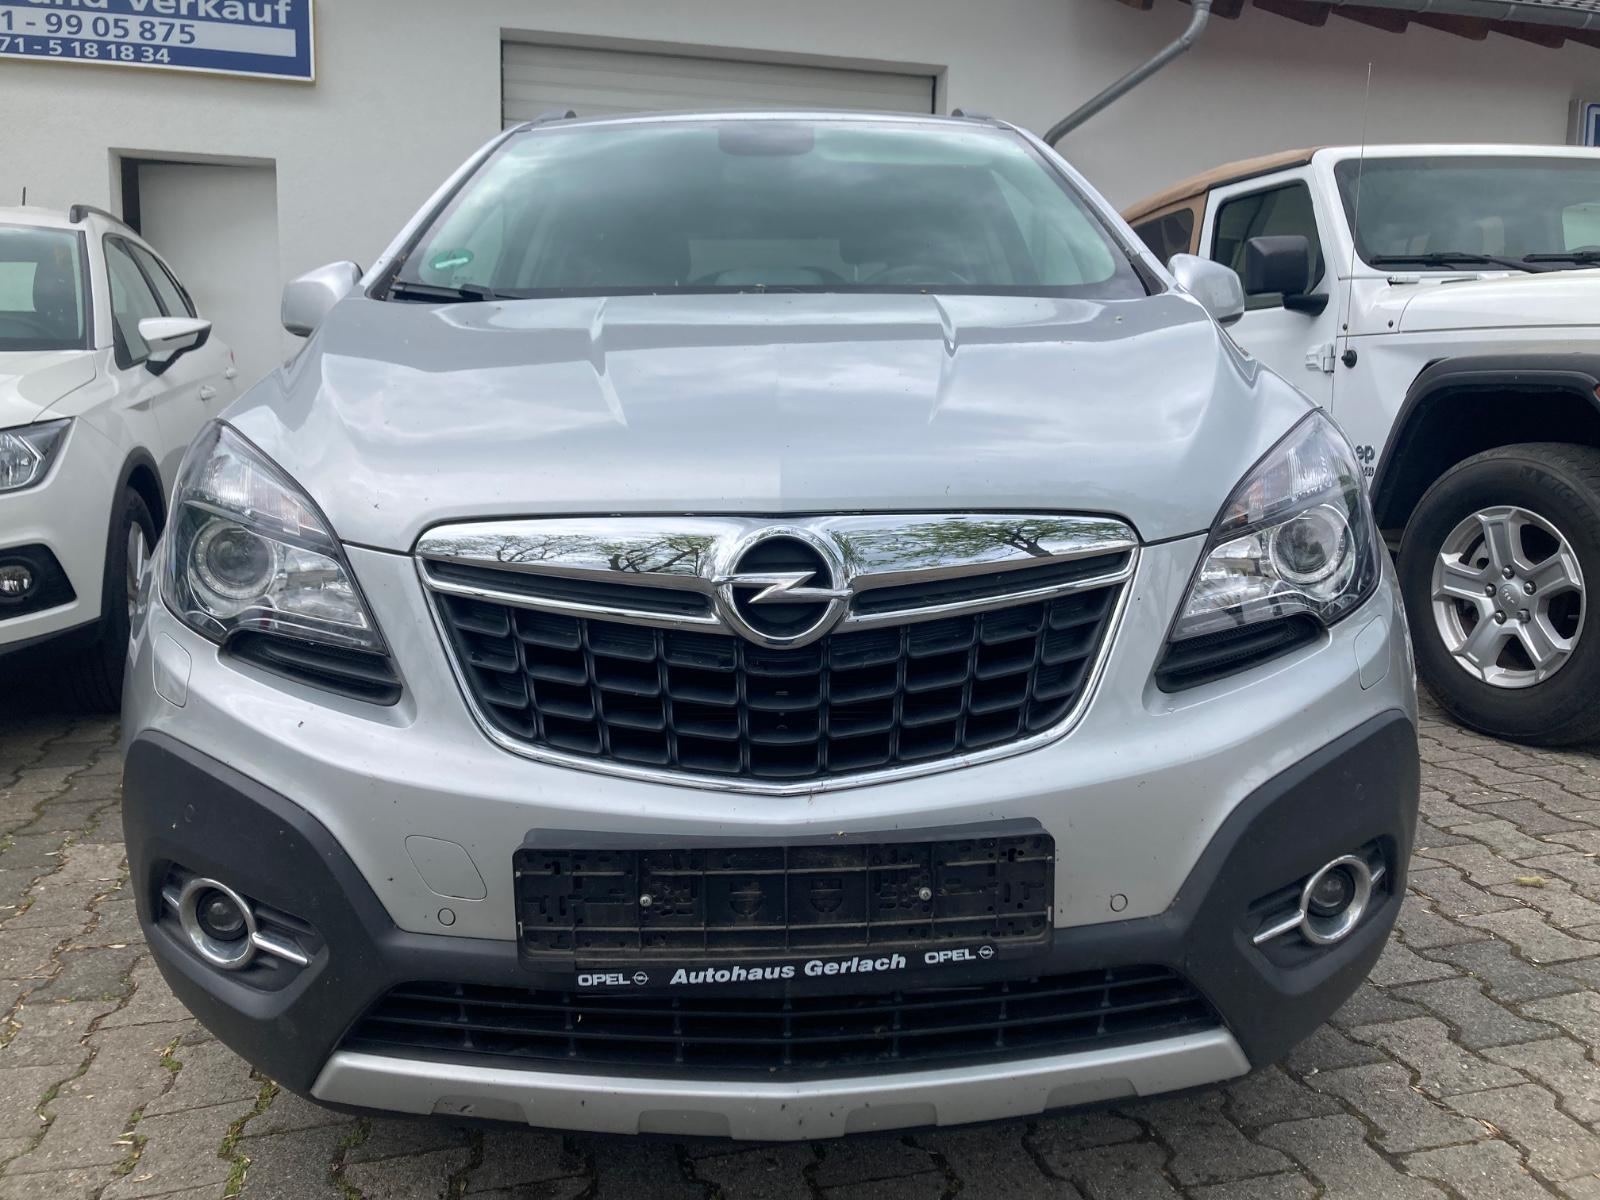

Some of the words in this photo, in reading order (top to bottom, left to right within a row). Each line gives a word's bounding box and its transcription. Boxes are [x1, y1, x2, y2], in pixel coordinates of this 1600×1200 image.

[45, 12, 83, 35] 99
[92, 16, 129, 39] 05
[138, 20, 196, 44] 875
[48, 39, 63, 55] 5
[70, 41, 99, 58] 18
[106, 43, 135, 61] 18
[141, 46, 171, 64] 34
[1355, 445, 1375, 464] ep
[577, 973, 631, 987] OPEL
[669, 965, 796, 985] Autohaus
[804, 953, 907, 977] Gerlach
[924, 948, 977, 964] OPEL
